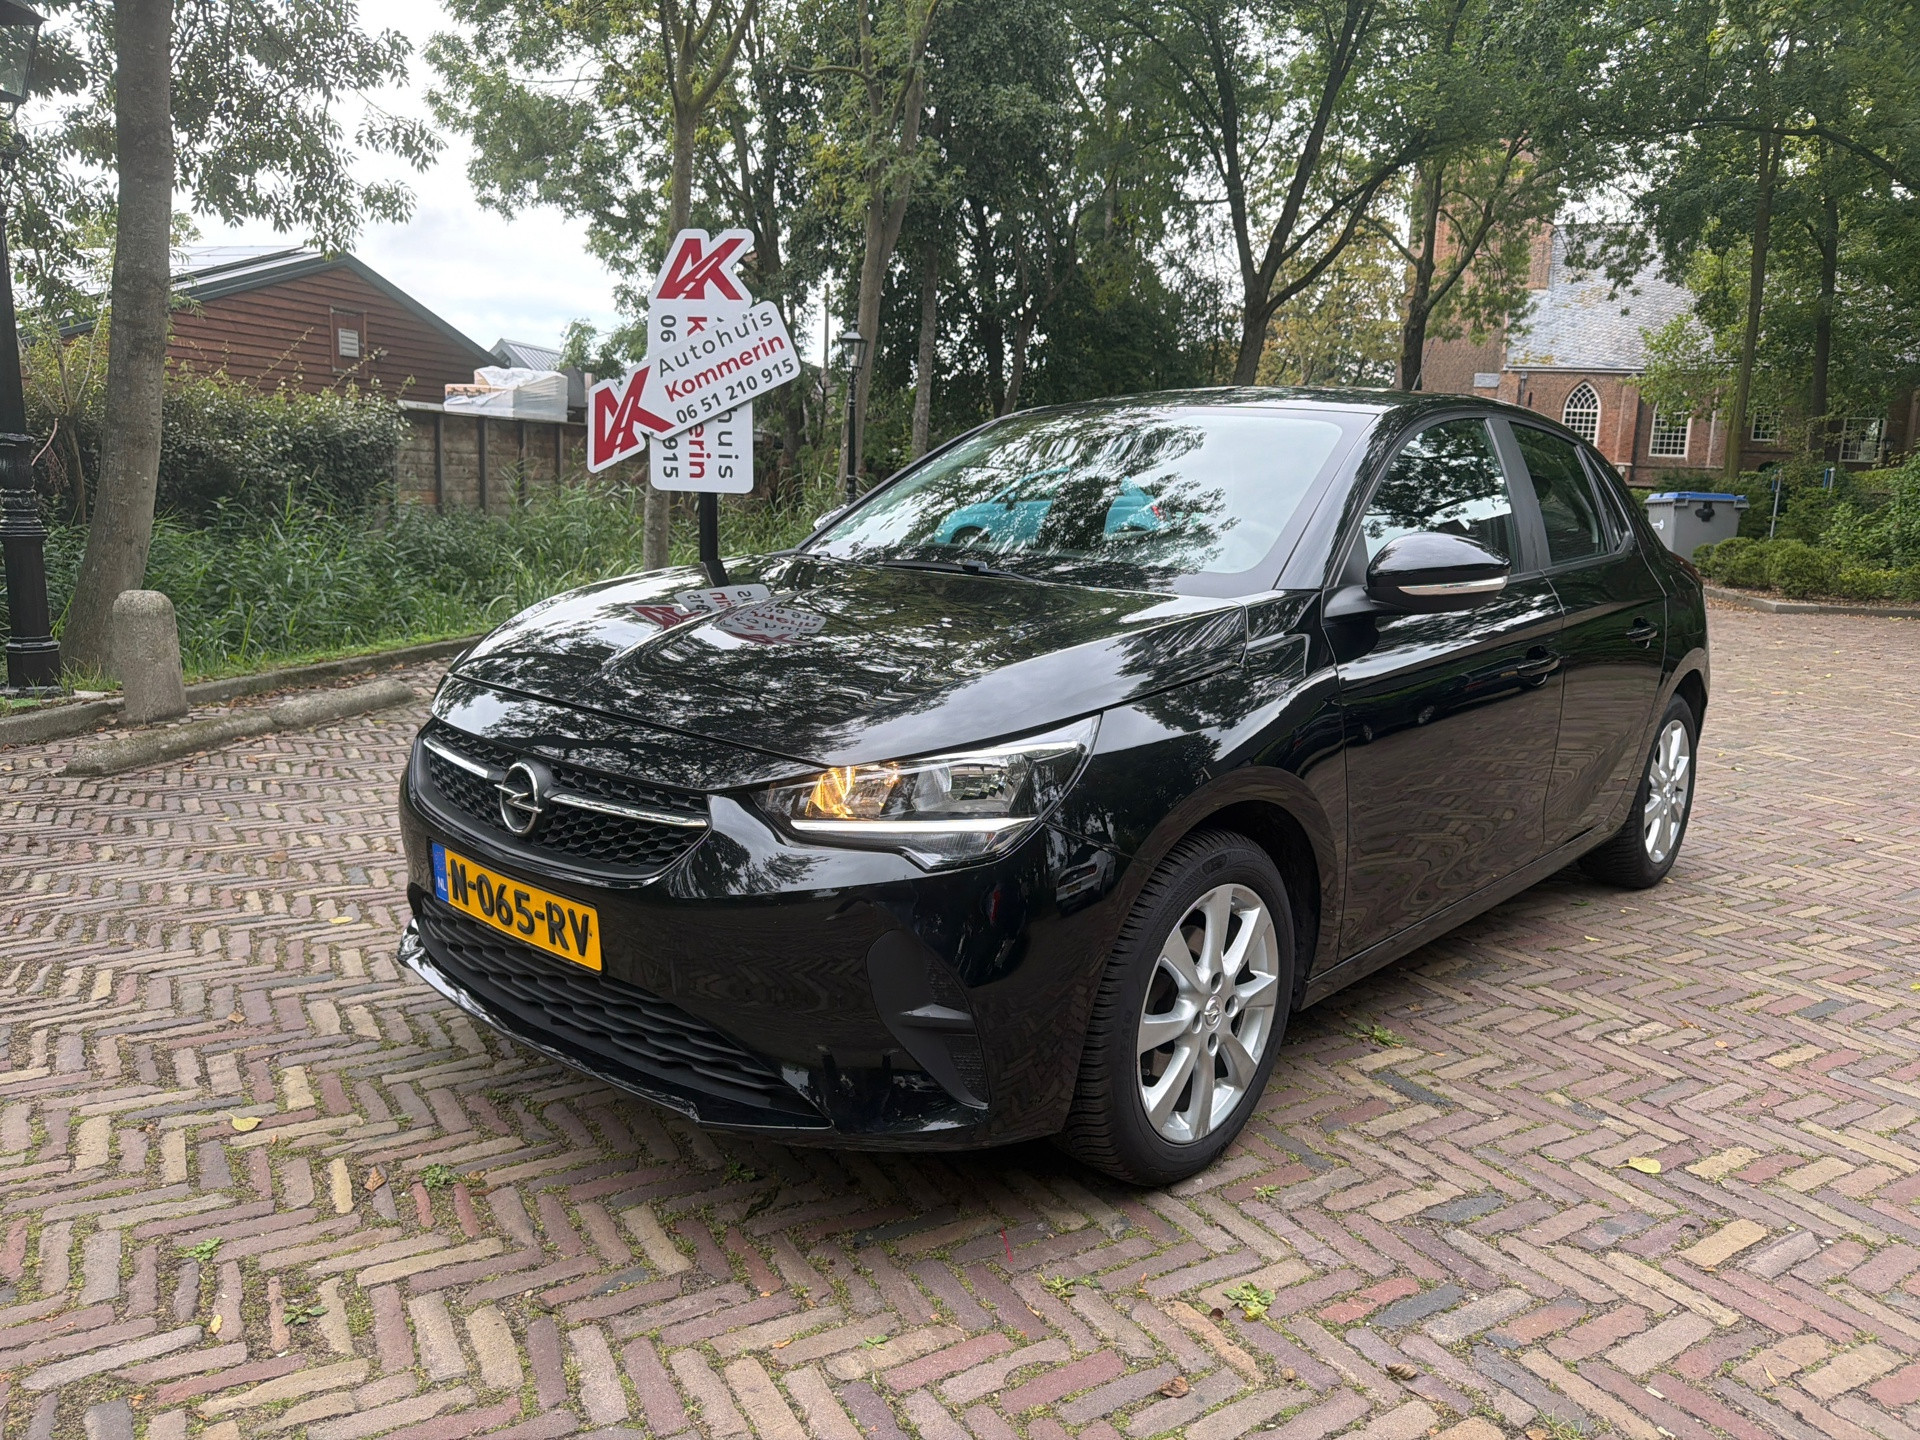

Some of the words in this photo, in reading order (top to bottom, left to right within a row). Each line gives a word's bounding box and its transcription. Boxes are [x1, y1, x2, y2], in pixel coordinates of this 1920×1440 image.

[659, 311, 773, 378] Autohuis
[660, 314, 677, 342] 06
[664, 336, 785, 402] Kommerin
[676, 404, 698, 424] 06
[700, 393, 721, 412] 51
[725, 376, 758, 400] 210
[761, 358, 794, 383] 915
[662, 437, 678, 478] 915
[437, 876, 447, 891] NL
[450, 858, 589, 957] N-065-RV
